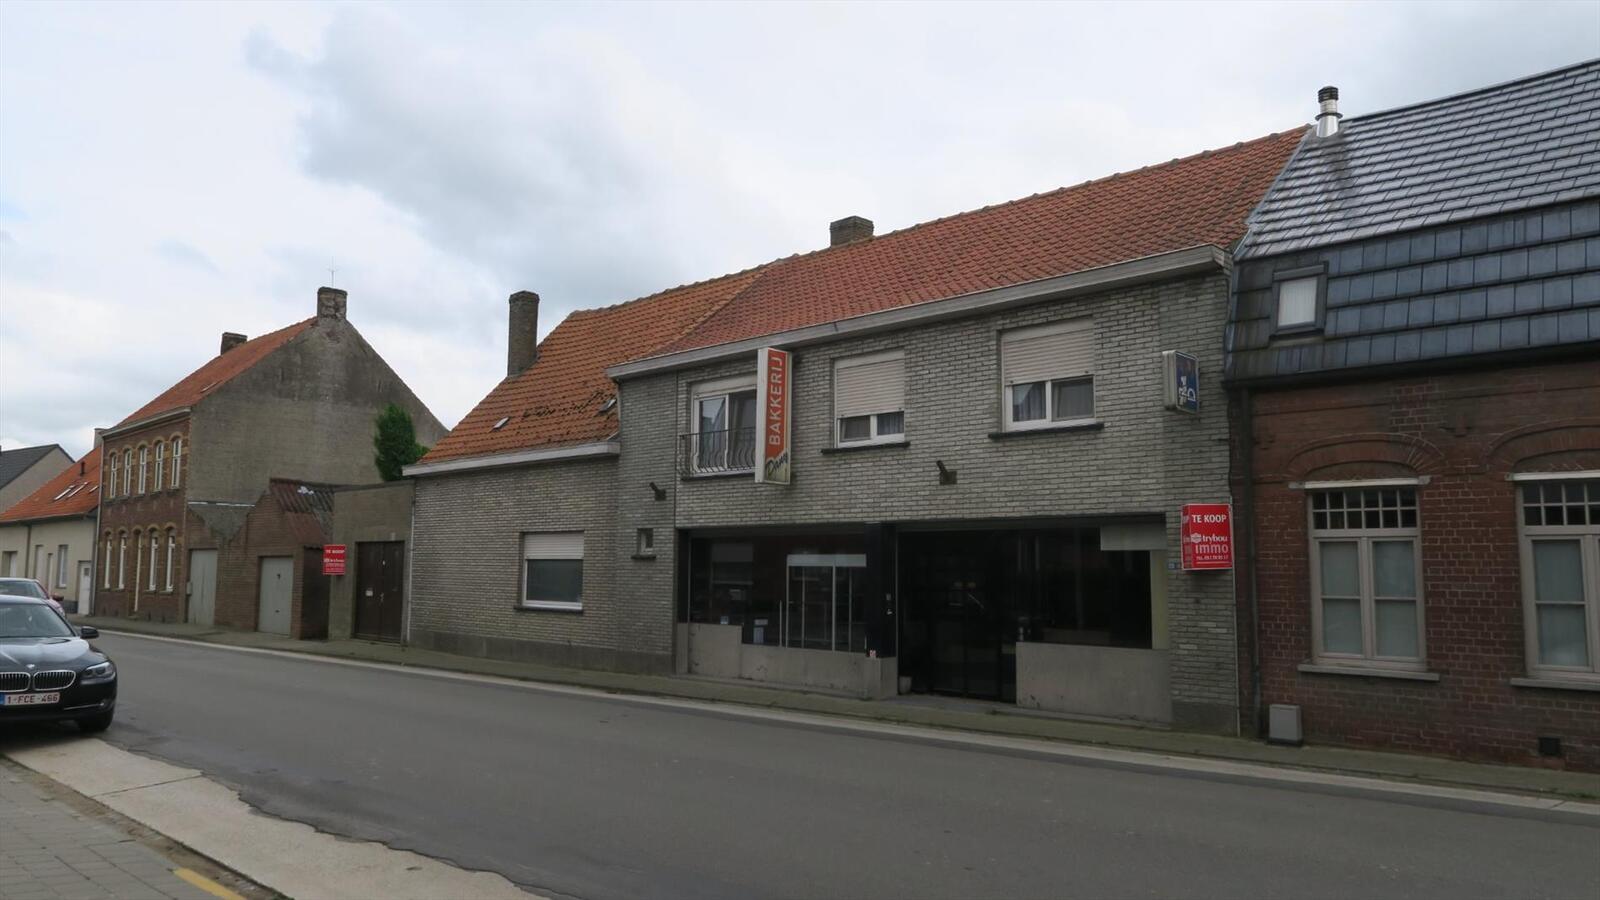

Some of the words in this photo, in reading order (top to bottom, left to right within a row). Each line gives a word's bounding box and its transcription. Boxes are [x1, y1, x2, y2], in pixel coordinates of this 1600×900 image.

[769, 356, 783, 446] BAKKERIJ
[1191, 514, 1202, 523] TE
[1203, 514, 1227, 523] KOOP
[1202, 533, 1228, 544] trybou
